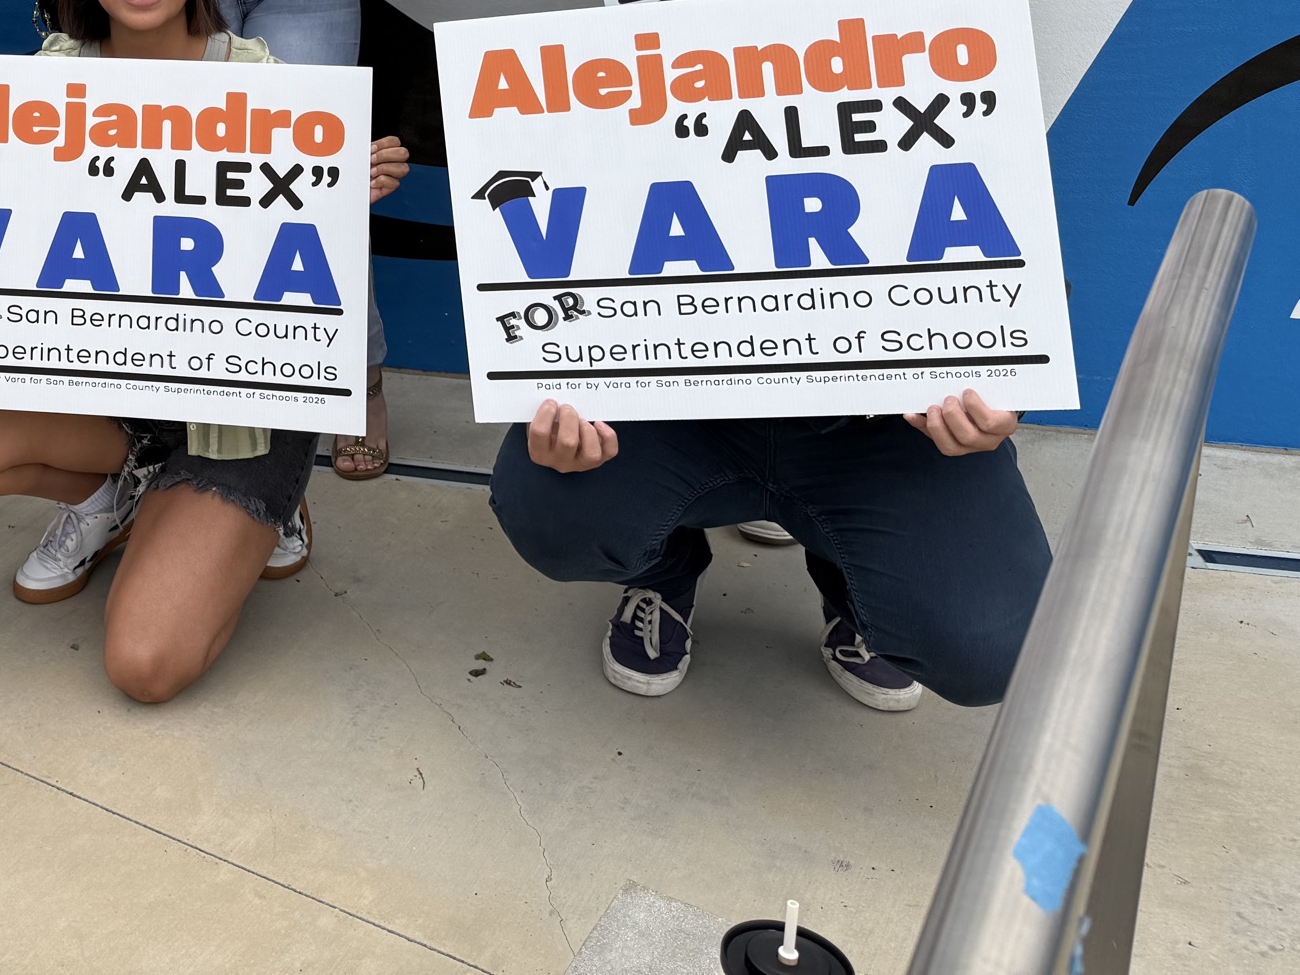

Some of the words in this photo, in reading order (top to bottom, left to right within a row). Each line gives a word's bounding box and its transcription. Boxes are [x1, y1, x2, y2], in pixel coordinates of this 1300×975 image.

[468, 18, 997, 126] Alejandro
[675, 91, 996, 163] “ALEX”
[88, 156, 339, 210] “ALEX”
[498, 163, 1021, 280] VARA
[6, 305, 58, 326] San
[71, 308, 224, 335] Bernardino
[236, 318, 338, 347] County
[495, 292, 592, 345] FOR
[596, 297, 662, 319] San
[676, 287, 873, 315] Bernardino
[888, 280, 1022, 309] County
[188, 353, 216, 373] of
[225, 355, 337, 381] Schools
[541, 332, 819, 368] Superintendent
[833, 330, 867, 354] of
[880, 325, 1028, 353] Schools
[4, 375, 26, 384] Vara
[30, 377, 43, 385] for
[45, 378, 64, 386] San
[68, 379, 122, 390] Bernardino
[125, 383, 161, 394] County
[164, 386, 242, 399] Superintendent
[259, 392, 299, 403] Schools
[302, 395, 326, 404] 2026
[537, 381, 562, 390] Paid
[566, 381, 582, 390] for
[586, 381, 600, 391] by
[603, 380, 632, 389] Vara
[635, 379, 651, 388] for
[655, 379, 679, 387] San
[684, 377, 752, 387] Bernardino
[756, 376, 802, 385] County
[806, 372, 908, 384] Superintendent
[912, 371, 925, 381] of
[930, 370, 982, 380] Schools
[986, 369, 1018, 379] 2026
